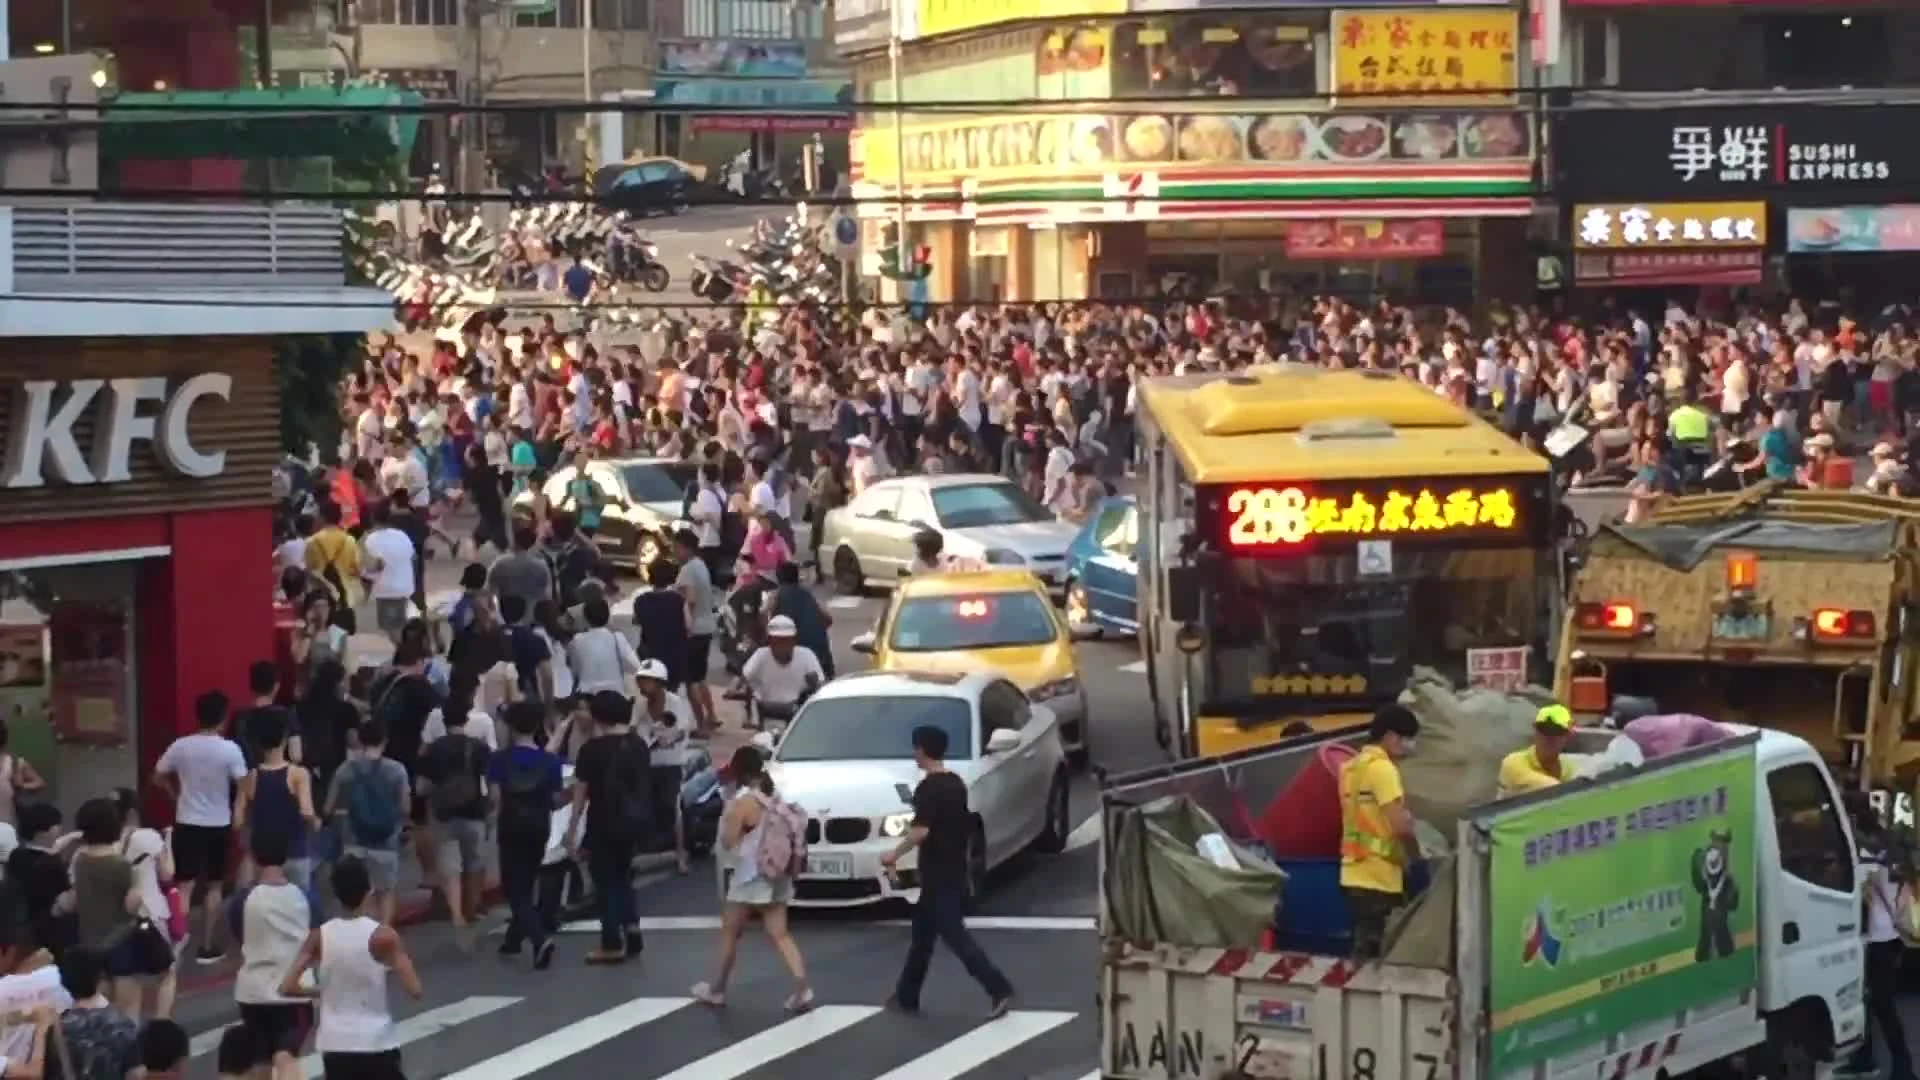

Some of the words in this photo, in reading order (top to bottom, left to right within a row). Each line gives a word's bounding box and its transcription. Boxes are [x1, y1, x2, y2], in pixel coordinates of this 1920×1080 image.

[1789, 143, 1857, 161] SUSHI
[1789, 161, 1890, 180] EXPRESS
[6, 372, 232, 487] KFC
